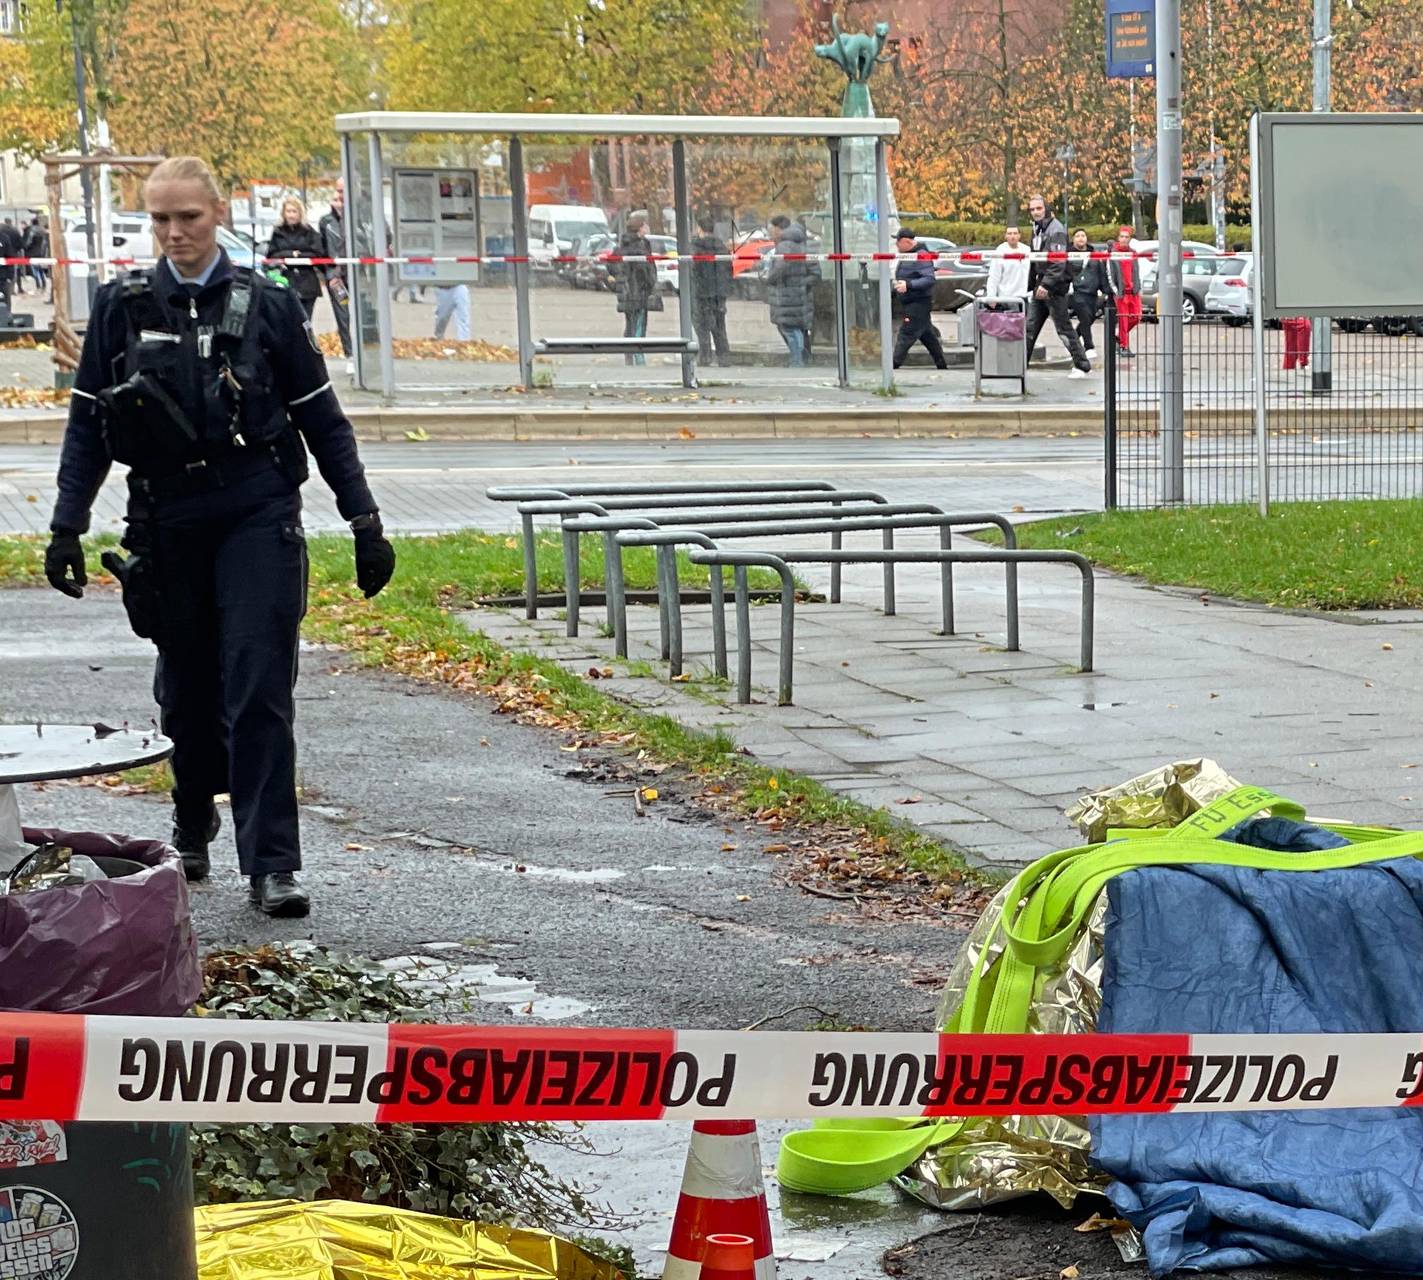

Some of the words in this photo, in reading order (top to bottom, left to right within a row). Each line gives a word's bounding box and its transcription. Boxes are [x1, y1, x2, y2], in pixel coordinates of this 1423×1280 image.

[118, 1036, 737, 1107] POLIZEIABSPERRUNG
[808, 1052, 1339, 1107] POLIZEIABSPERRUNG
[0, 1236, 51, 1262] EISS
[0, 1253, 53, 1279] SSEN
